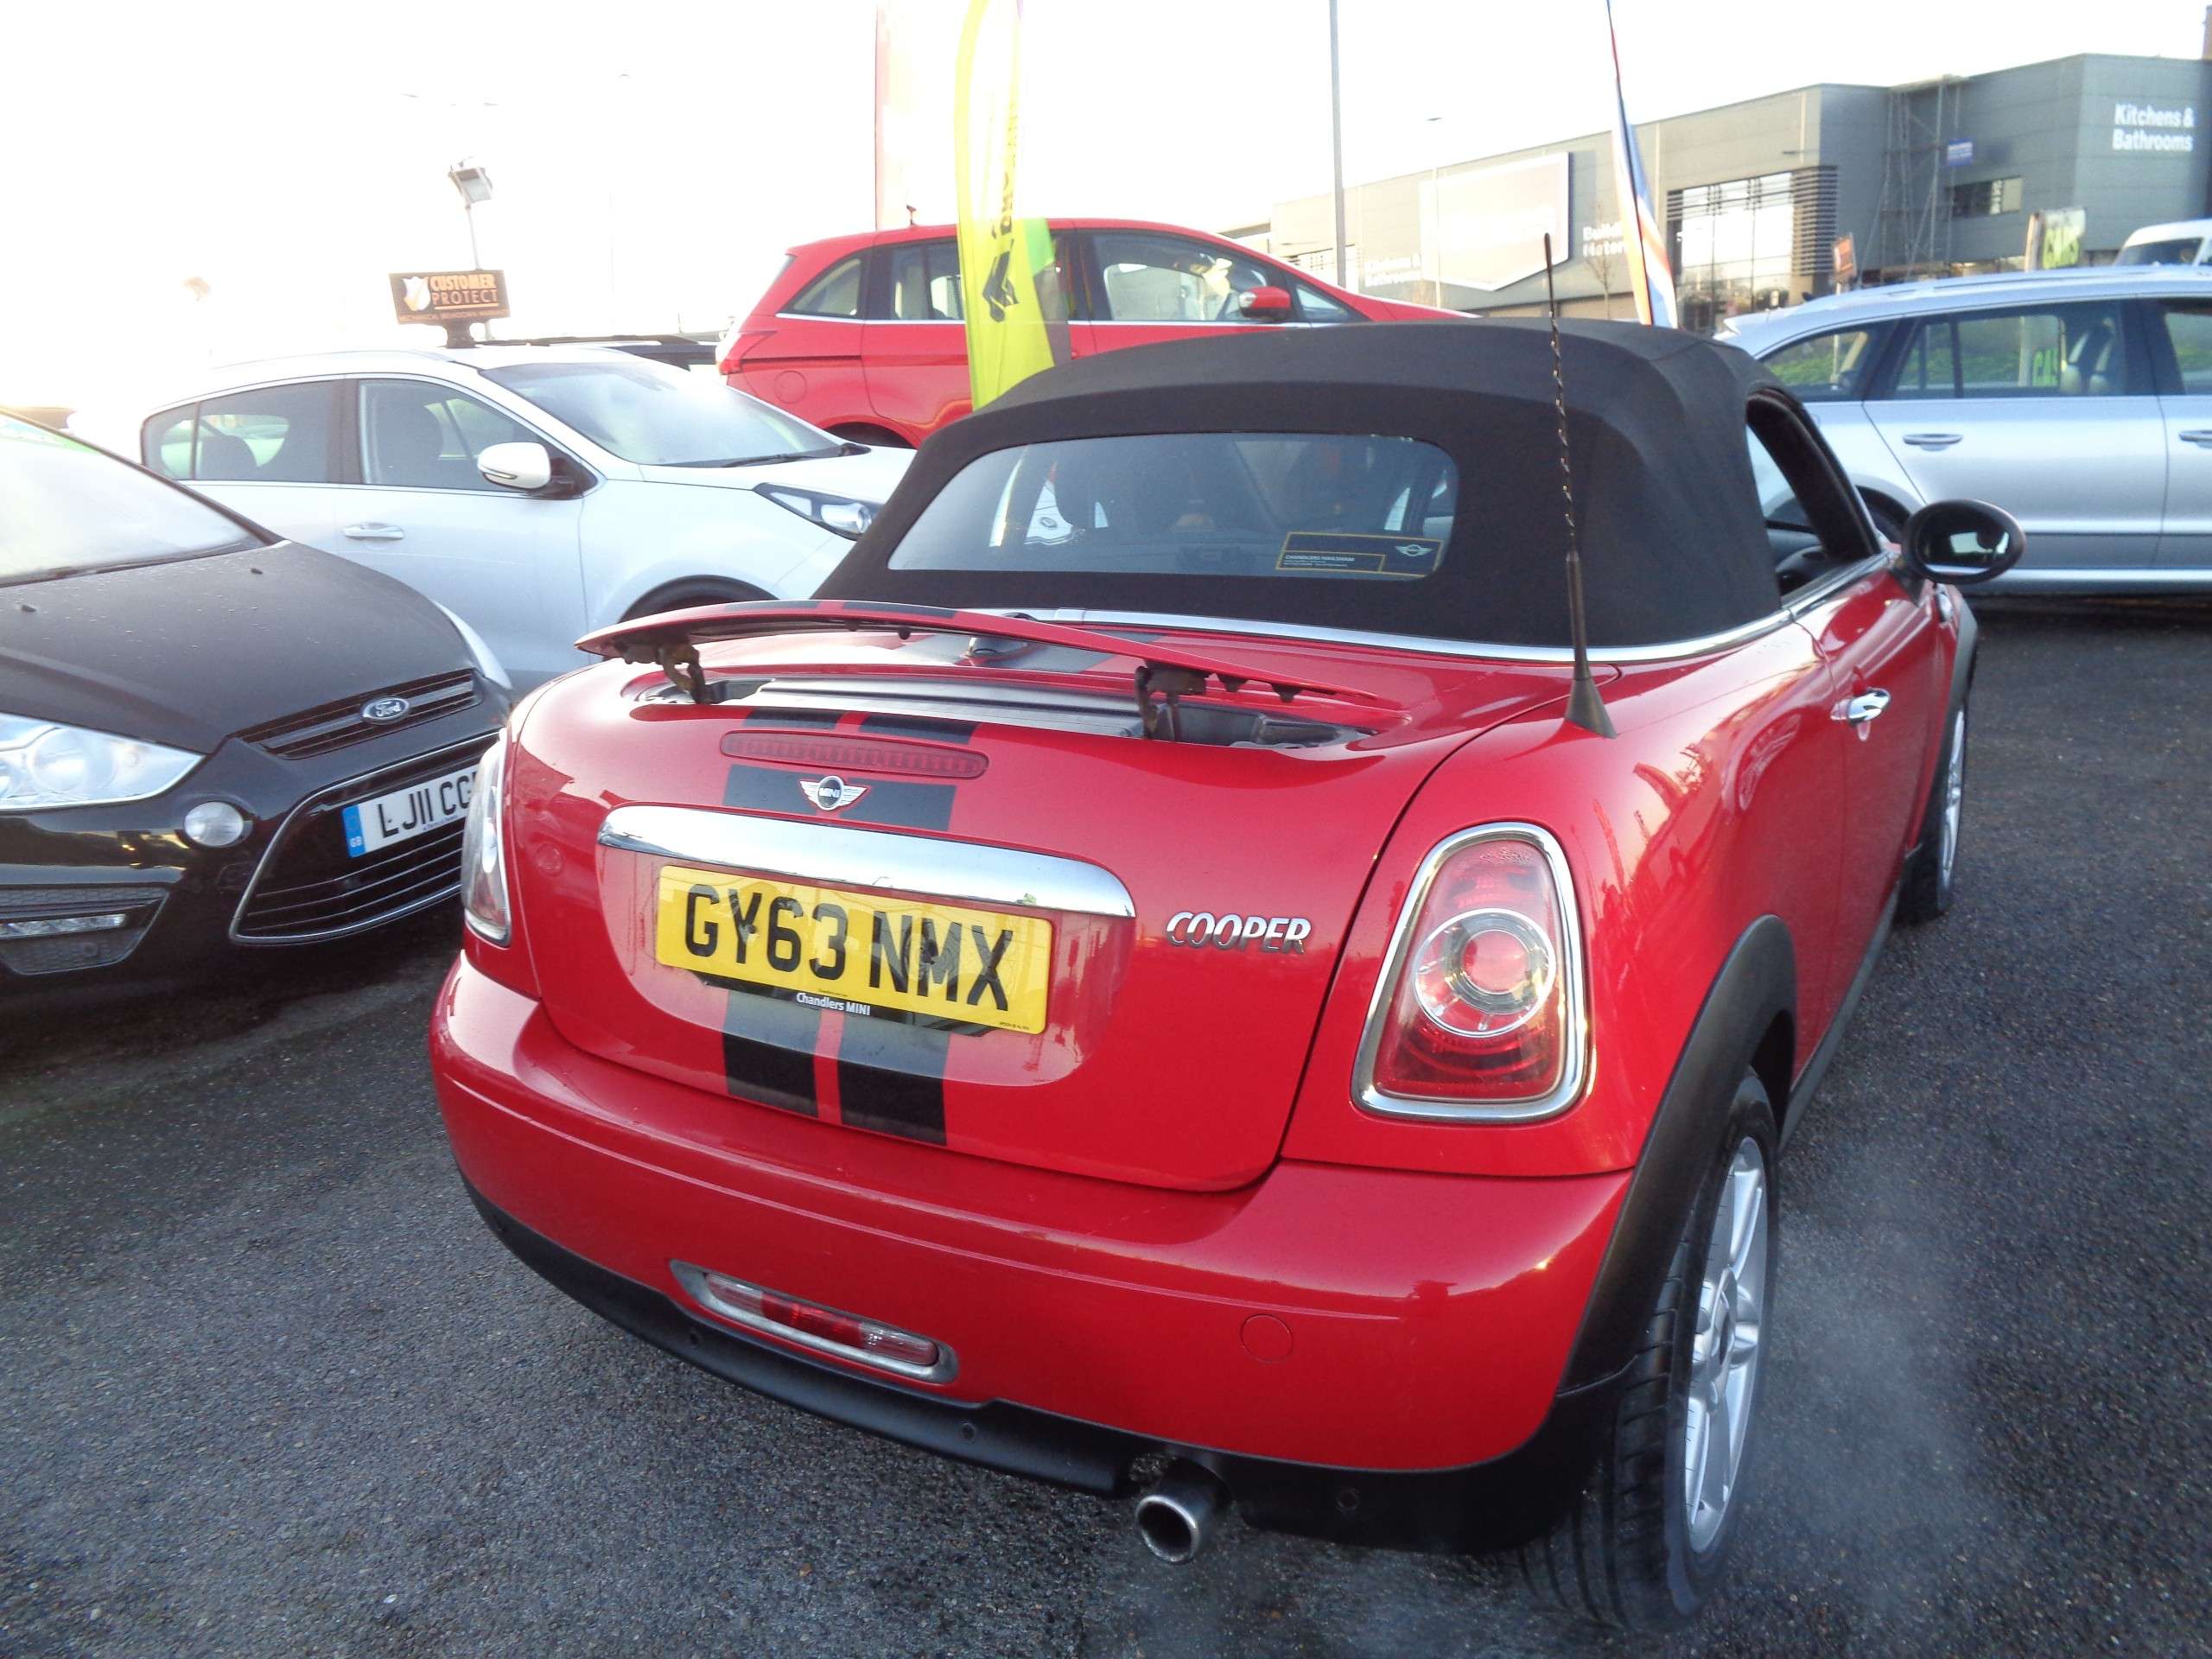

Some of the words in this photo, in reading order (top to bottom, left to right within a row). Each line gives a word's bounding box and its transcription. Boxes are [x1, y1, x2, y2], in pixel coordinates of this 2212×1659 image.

[2114, 103, 2182, 128] Kitchens
[2183, 107, 2195, 129] &
[2113, 129, 2193, 152] Bathrooms
[429, 274, 496, 292] CUSTOMER
[431, 289, 498, 306] PROTECT
[818, 787, 842, 798] MINI
[377, 787, 434, 839] LJ11
[349, 835, 363, 848] GB
[1166, 912, 1312, 954] COOPER
[685, 884, 849, 981] GY63
[868, 911, 1014, 1012] NMX
[796, 992, 844, 1011] Chandlers
[845, 1001, 871, 1016] MINI
